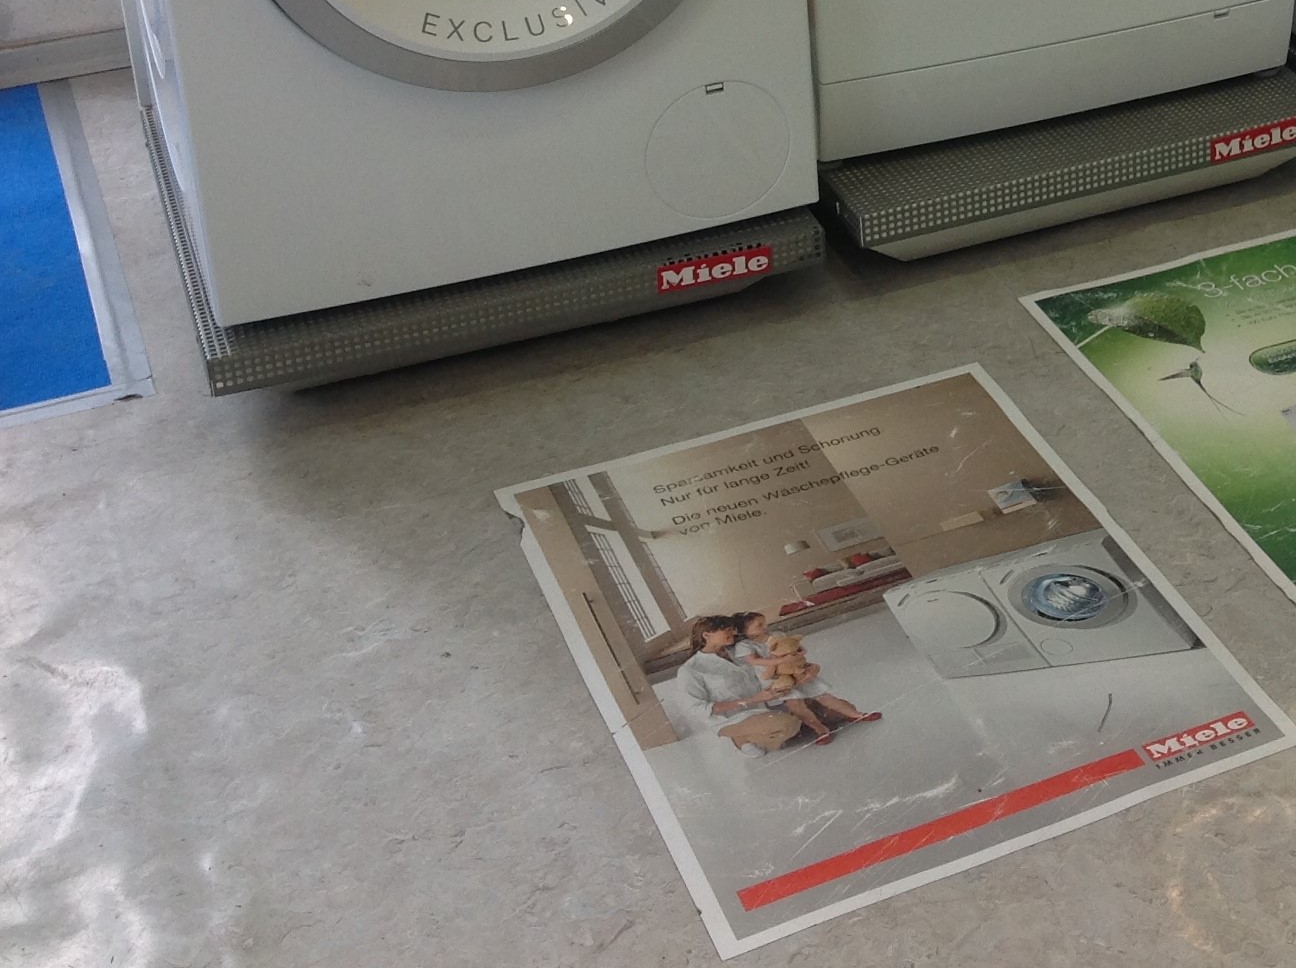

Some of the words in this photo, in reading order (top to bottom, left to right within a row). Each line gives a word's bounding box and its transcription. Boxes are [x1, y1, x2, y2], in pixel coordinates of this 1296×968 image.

[661, 253, 769, 290] Miele
[652, 459, 760, 496] Sparsamkeit
[762, 449, 794, 465] und
[797, 426, 882, 455] Schonung
[660, 492, 692, 508] Nur
[696, 482, 721, 497] für
[722, 472, 771, 493] lange
[775, 460, 811, 478] Zeit!
[671, 511, 701, 527] Die
[706, 496, 760, 516] neuen
[762, 444, 940, 502] Wäschepflege-Geräte
[678, 522, 712, 536] von
[1146, 717, 1249, 758] Miele
[1209, 727, 1262, 750] BESSER
